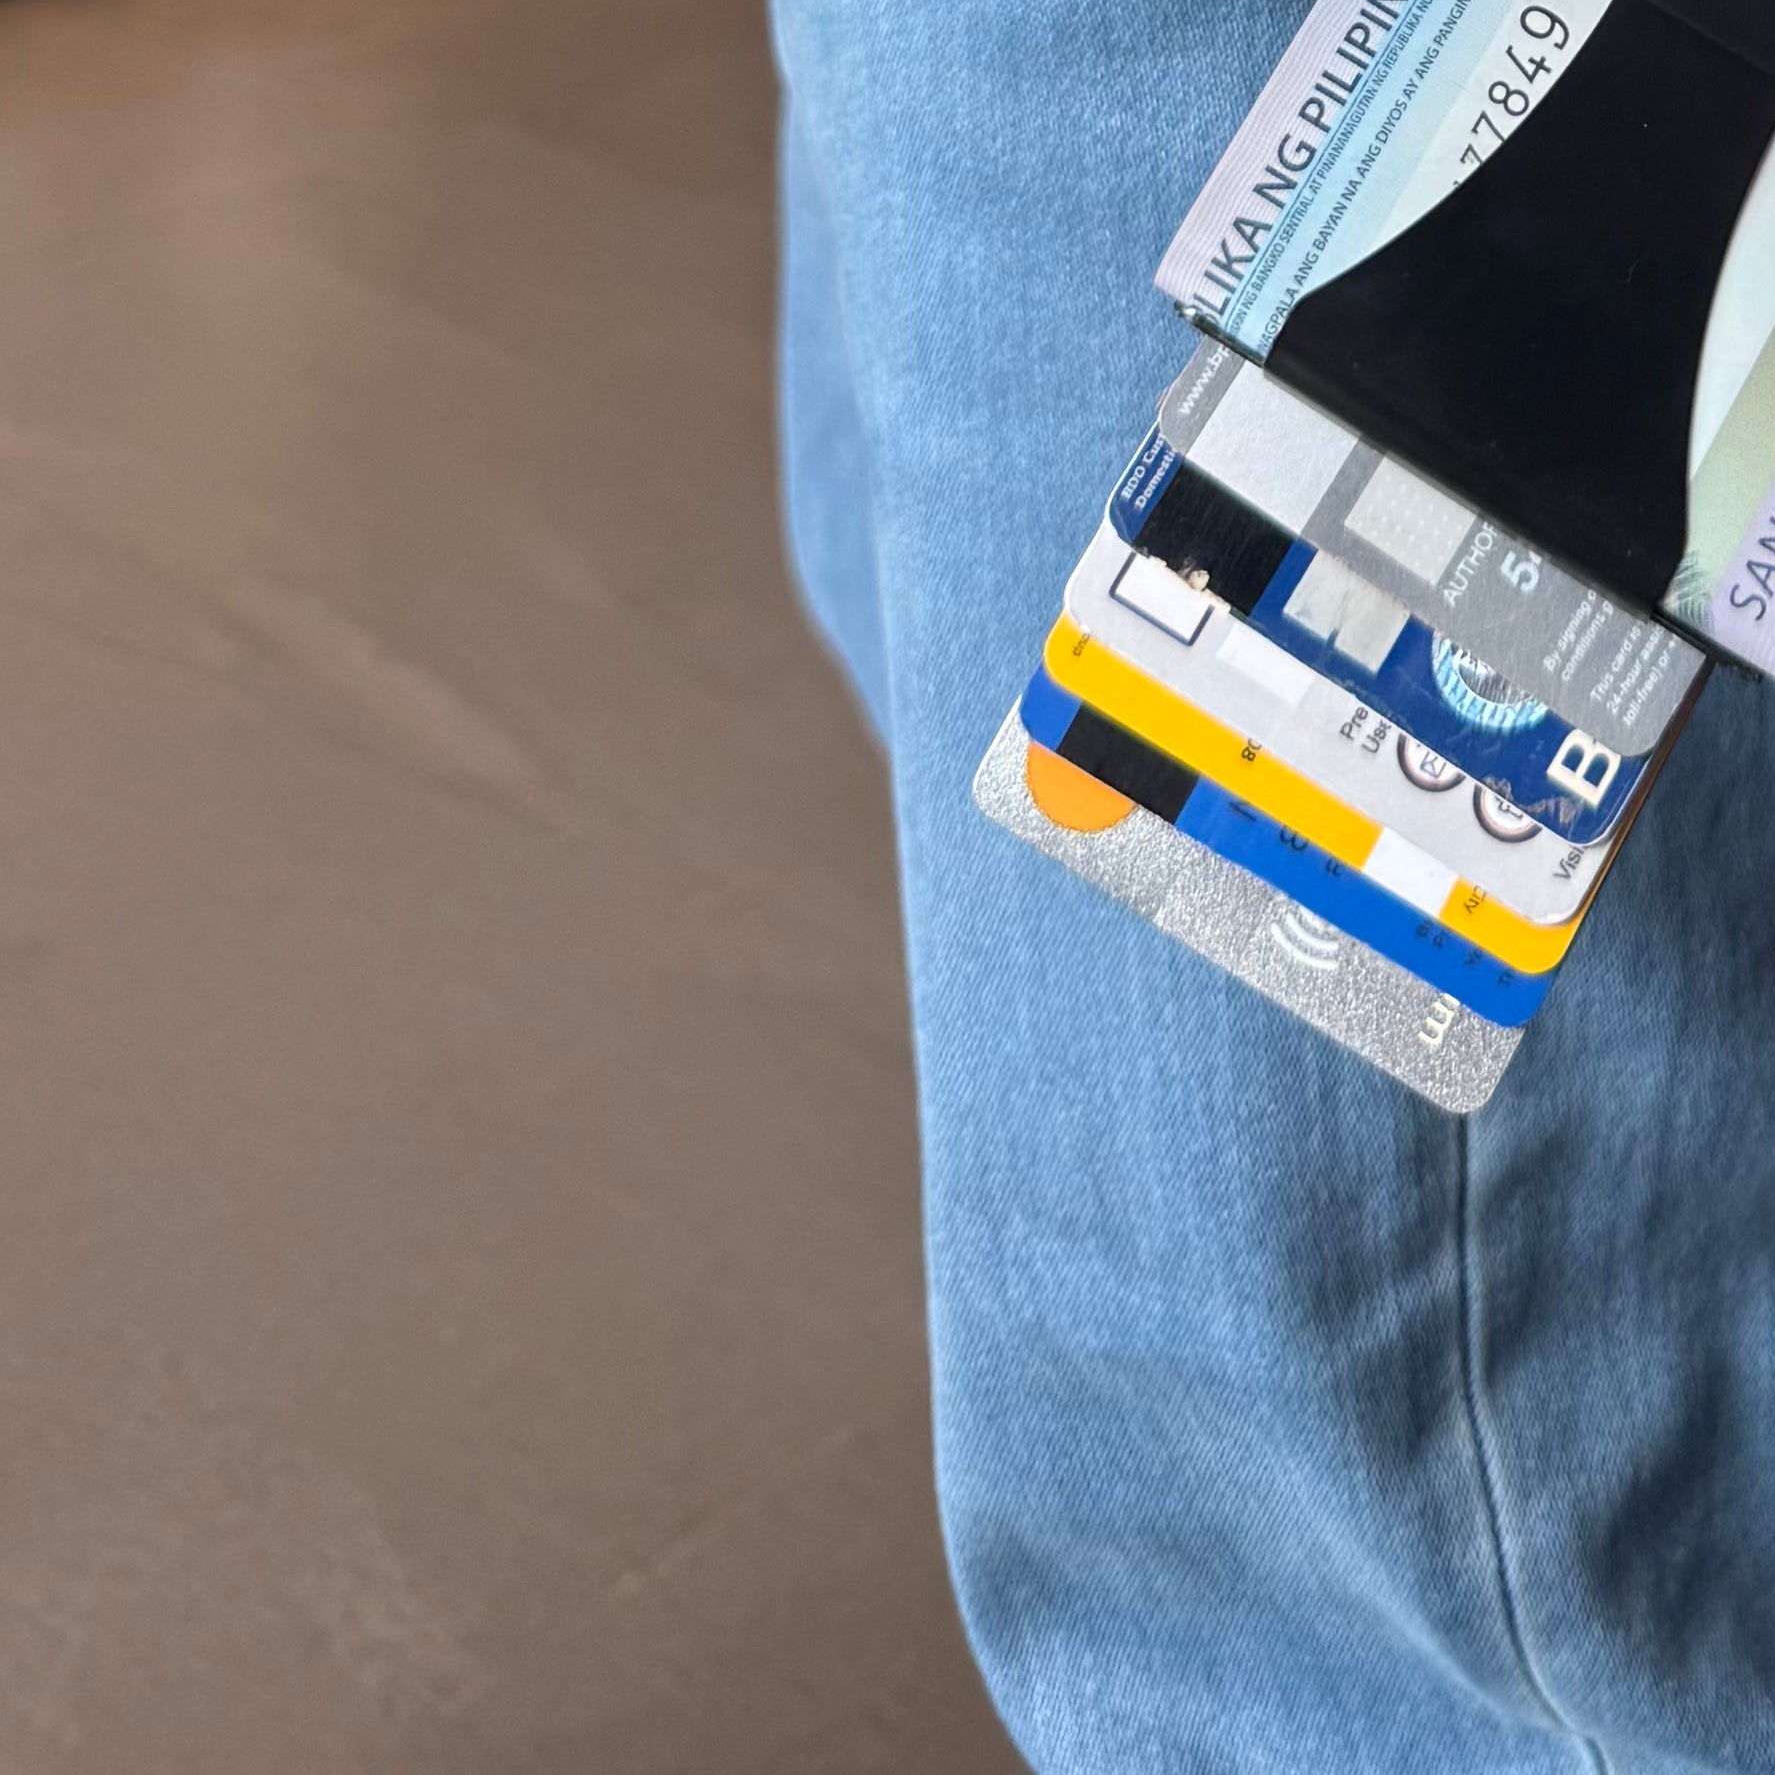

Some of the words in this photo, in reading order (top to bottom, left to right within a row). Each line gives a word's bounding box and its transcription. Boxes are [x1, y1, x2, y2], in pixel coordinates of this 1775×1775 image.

[1380, 10, 1423, 69] REPUBLIKA
[1370, 66, 1389, 86] NG
[1312, 84, 1381, 180] PINANANAGUTAN
[1267, 132, 1318, 211] NG
[1290, 249, 1320, 286] ANG
[1310, 200, 1349, 251] BAYAN
[1339, 176, 1363, 202] NA
[1353, 142, 1383, 178] ANG
[1372, 97, 1409, 144] DIYOS
[1400, 78, 1420, 100] AY
[1412, 45, 1440, 79] ANG
[1306, 176, 1323, 195] AT
[1276, 192, 1315, 244] SENTRAL
[1249, 241, 1287, 292] BANGKO
[1240, 289, 1258, 310] NG
